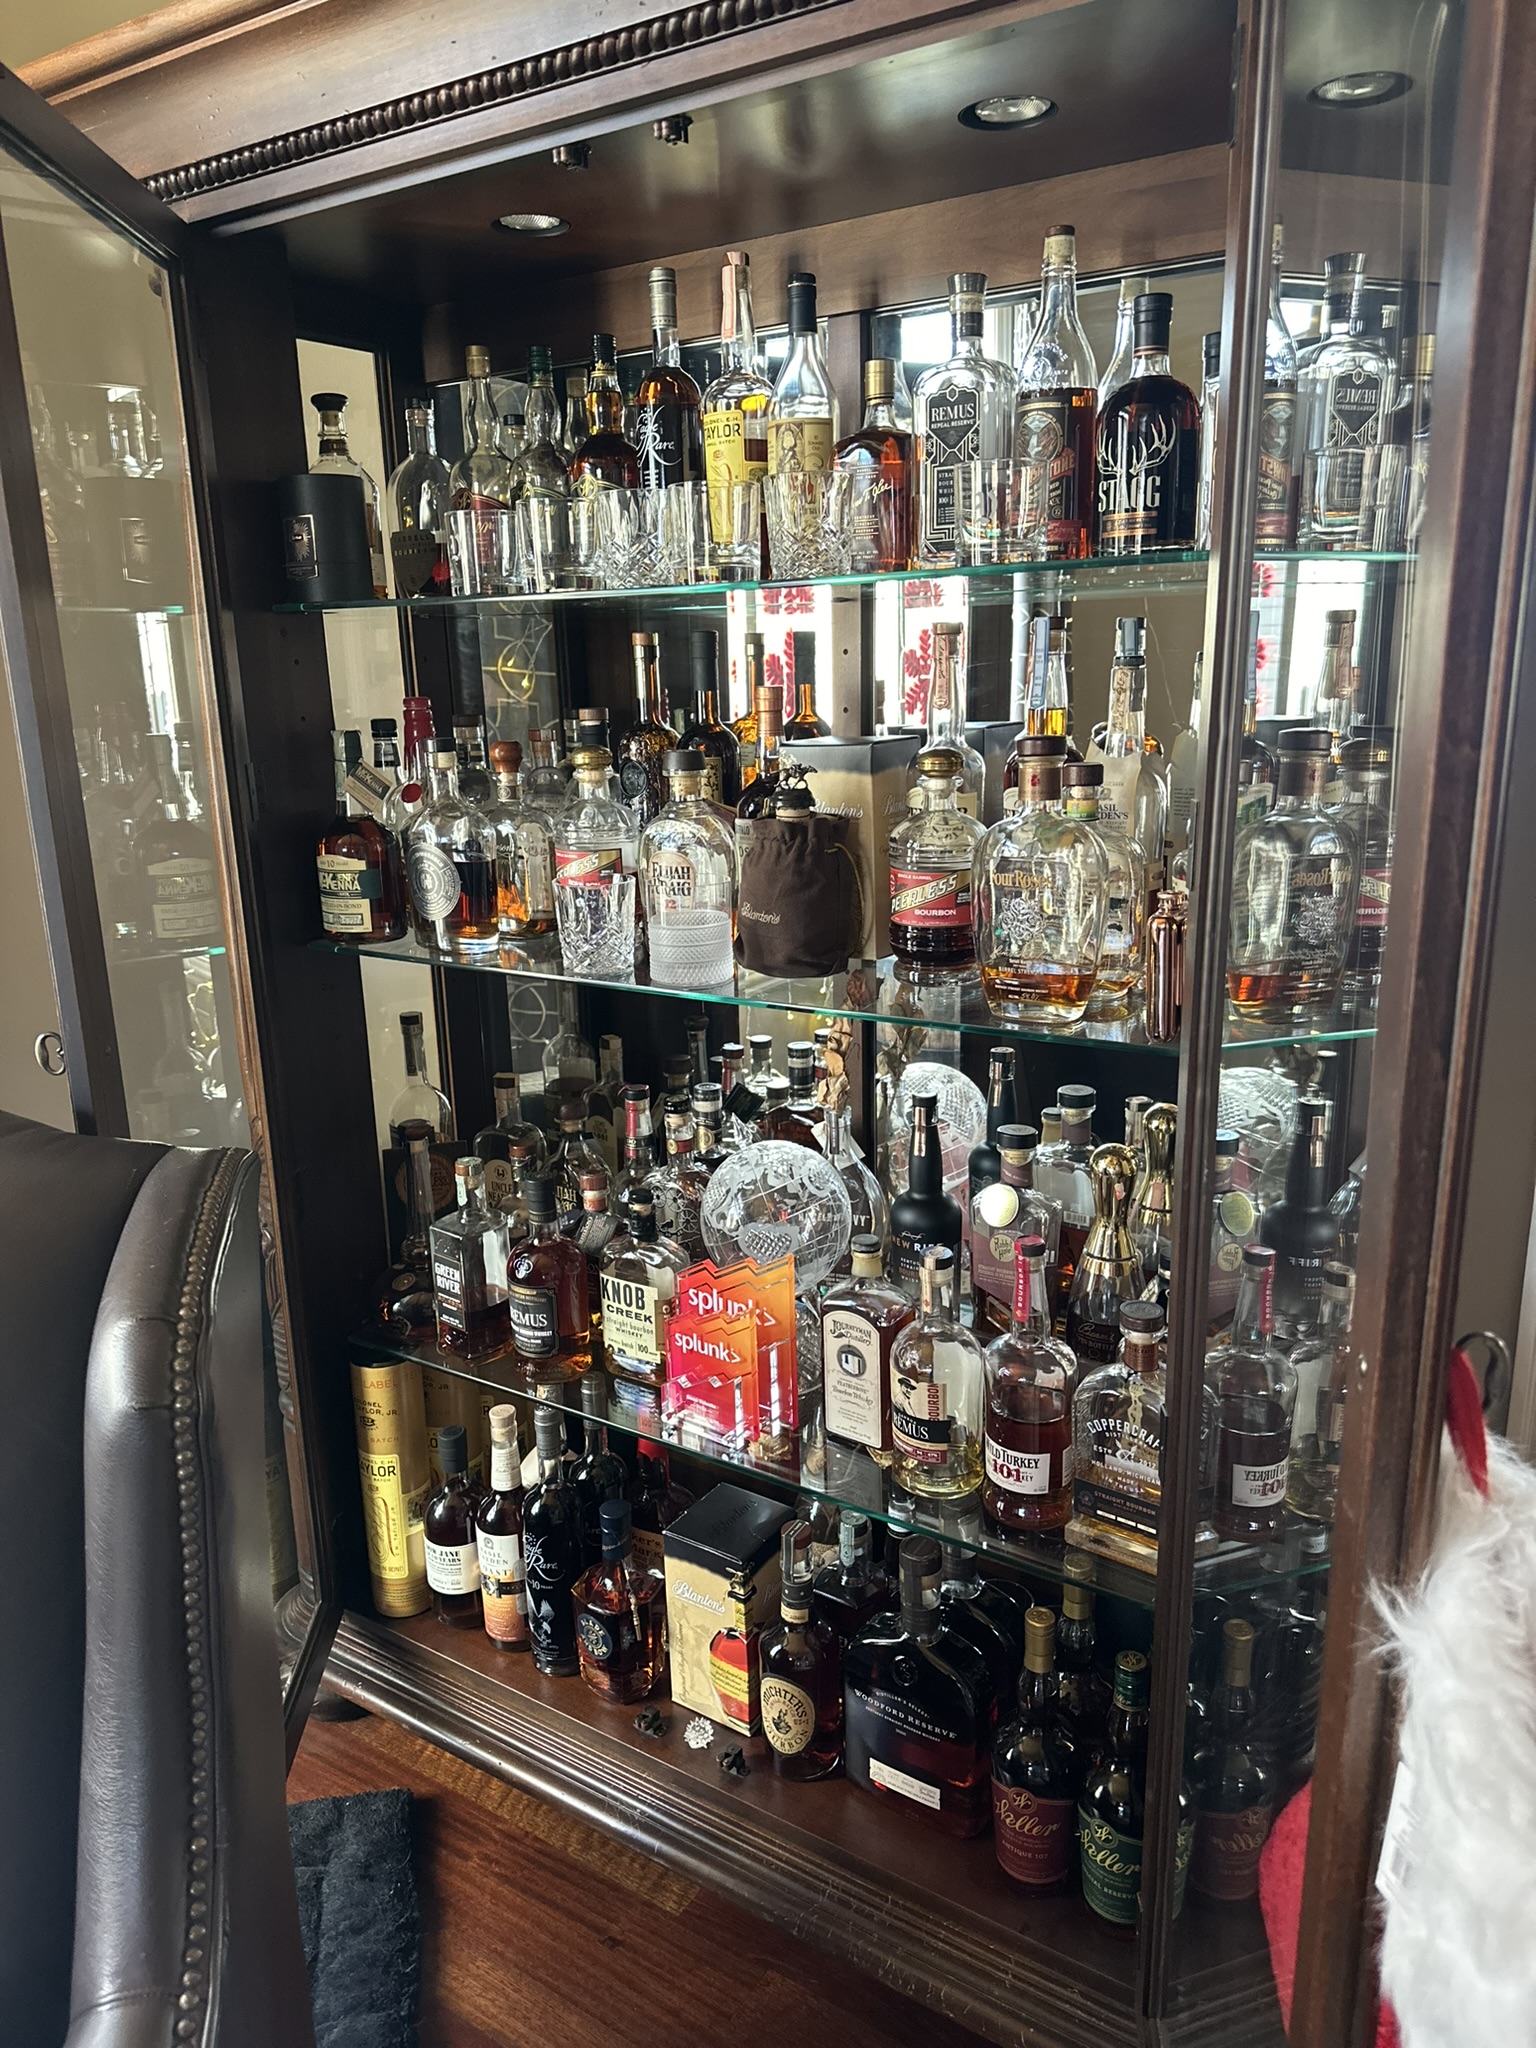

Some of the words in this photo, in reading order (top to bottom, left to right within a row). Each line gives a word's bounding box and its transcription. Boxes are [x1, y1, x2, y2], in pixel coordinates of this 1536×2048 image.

[931, 403, 975, 422] REMUS
[931, 422, 951, 430] REPEAL
[951, 418, 975, 427] RESERVE
[1098, 475, 1161, 512] STAGG
[327, 860, 335, 868] 10
[652, 862, 691, 880] ELIJAH
[891, 873, 958, 914] PEERLESS
[914, 908, 957, 916] BOURBON
[435, 1262, 460, 1282] GREEN
[436, 1275, 461, 1295] RIVER
[601, 1277, 646, 1311] KNOB
[606, 1304, 653, 1325] CREEK
[615, 1327, 643, 1338] WHISKEY
[629, 1321, 654, 1334] bourbon
[830, 1319, 872, 1340] JOURNEYMAN
[637, 1343, 649, 1354] 100
[927, 1382, 940, 1422] BOURBON
[893, 1411, 929, 1440] REMUS
[1105, 1431, 1148, 1449] DISTILLERY
[986, 1437, 1001, 1460] WILD
[1000, 1448, 1041, 1469] TURKEY
[1139, 1458, 1157, 1469] 2012
[992, 1458, 1023, 1483] 101
[1091, 1459, 1126, 1476] HOLLAND,
[1126, 1470, 1161, 1486] MICHIGAN
[1093, 1490, 1125, 1506] STRAIGHT
[1126, 1500, 1157, 1516] BOURBON
[439, 1550, 461, 1558] JANE
[672, 1580, 726, 1614] Blanton's
[763, 1686, 808, 1719] MICHTER'S
[854, 1688, 905, 1719] WOODFORD
[907, 1715, 956, 1739] RESERVE
[994, 1796, 1061, 1837] Weller
[1002, 1840, 1033, 1859] ANTIQUE
